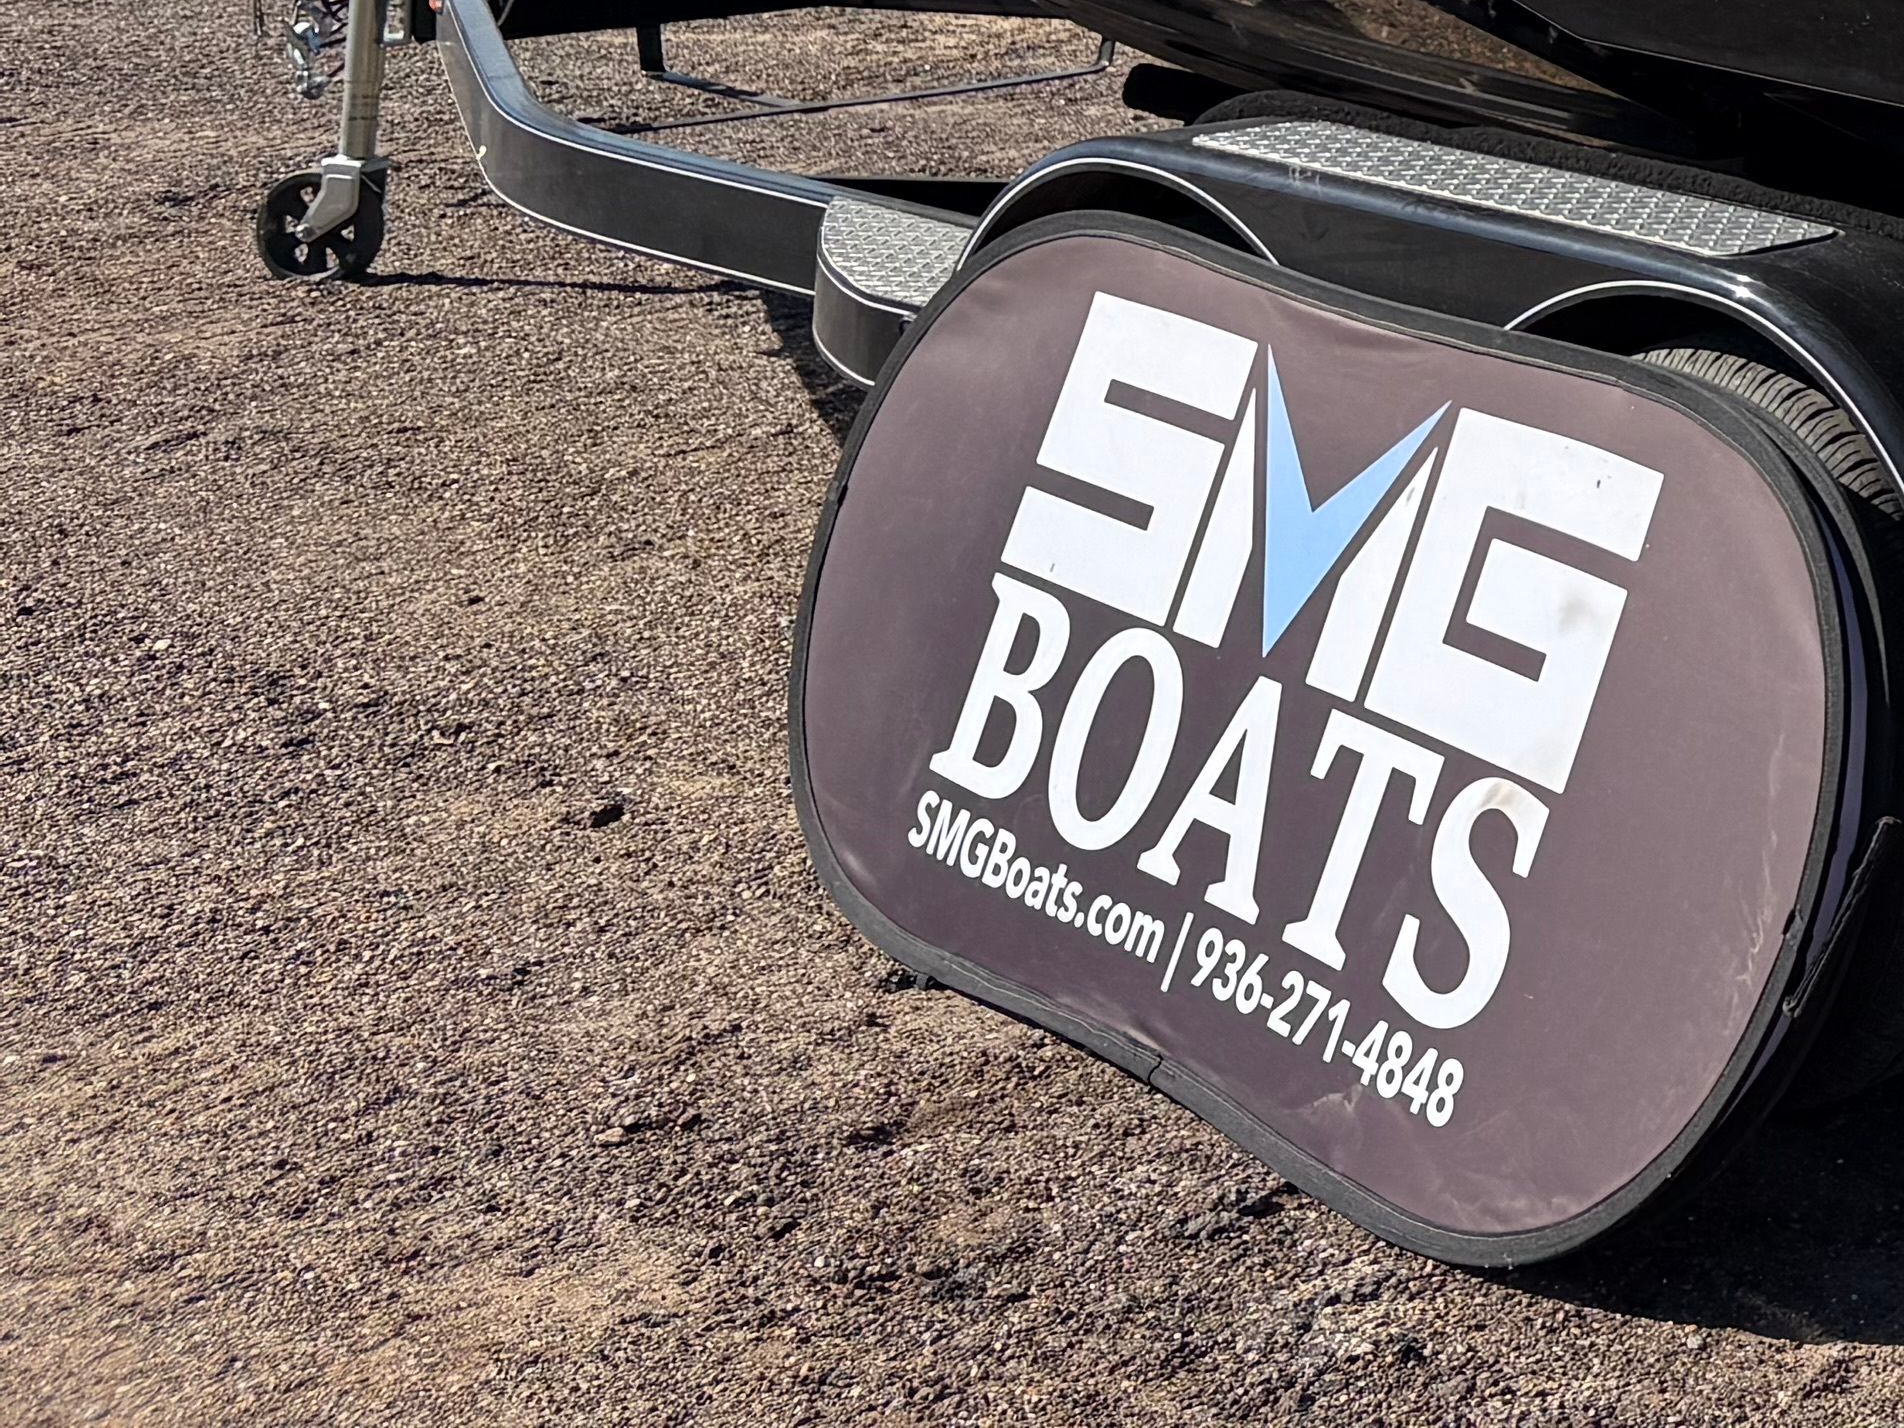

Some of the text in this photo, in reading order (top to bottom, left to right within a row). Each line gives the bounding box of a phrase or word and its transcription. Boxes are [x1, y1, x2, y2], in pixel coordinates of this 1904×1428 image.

[1001, 291, 1665, 793] SMG
[908, 789, 1166, 965] SMGBoats.com
[1196, 926, 1465, 1127] 936-271-4848
[929, 571, 1550, 1030] BOATS
